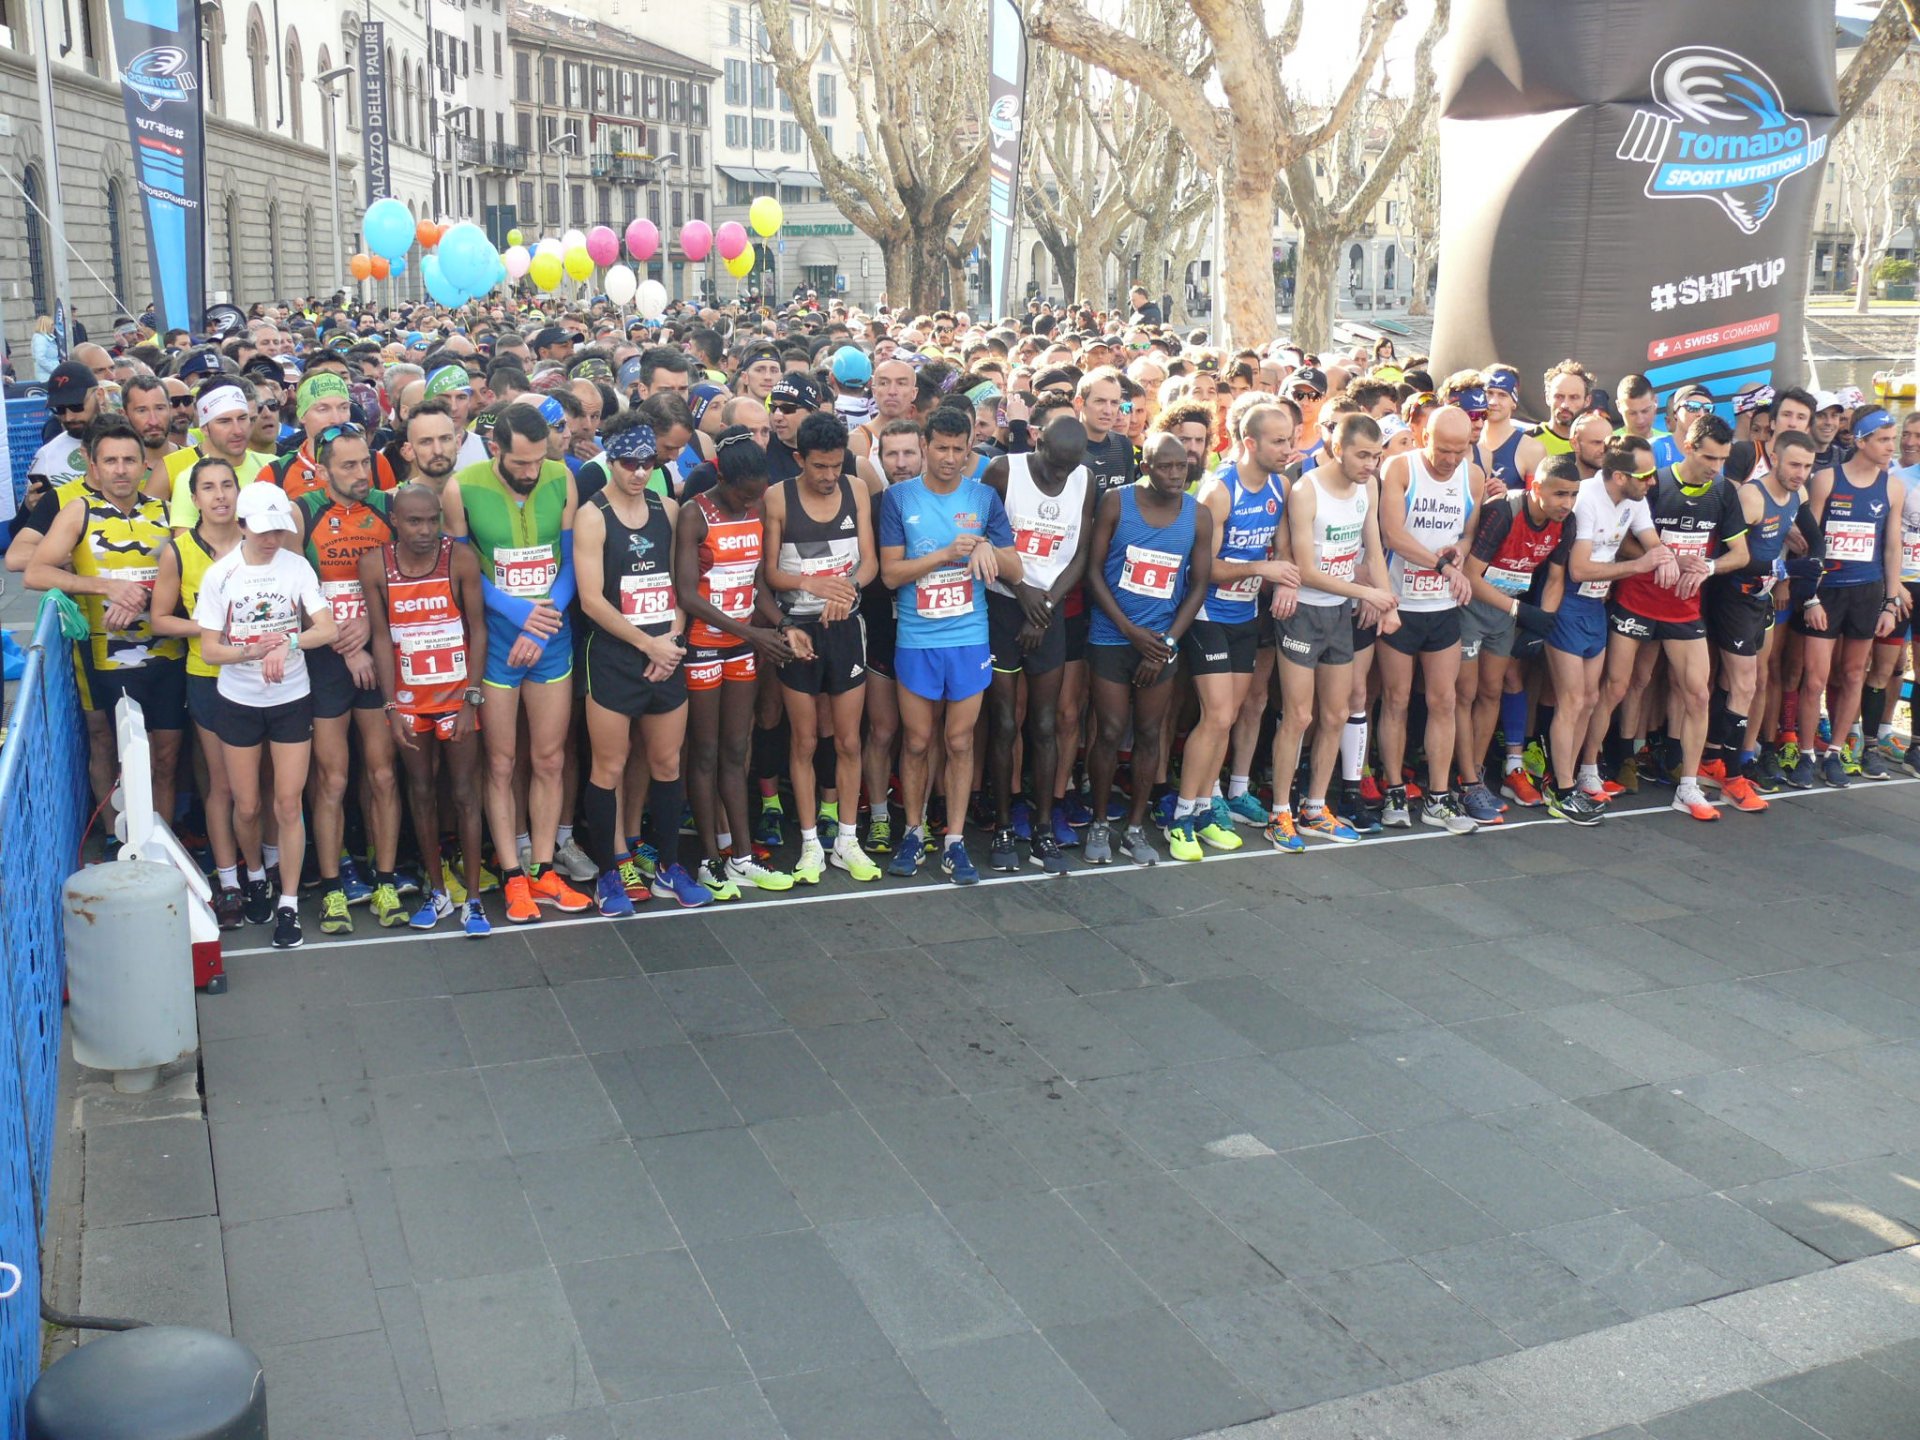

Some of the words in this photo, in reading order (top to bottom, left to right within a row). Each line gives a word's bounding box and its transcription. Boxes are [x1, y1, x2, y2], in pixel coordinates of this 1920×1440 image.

[364, 24, 378, 76] PAURE
[367, 81, 382, 127] DELLE
[369, 131, 386, 203] PALAZZO
[1665, 169, 1724, 186] SPORT
[1726, 153, 1803, 183] NUTRITION
[1650, 258, 1786, 312] #SHIFTUP
[1672, 341, 1683, 352] A
[1684, 332, 1720, 349] SWISS
[1722, 321, 1771, 341] COMPANY
[1043, 504, 1055, 515] 40
[1413, 498, 1438, 513] A.D.M.
[717, 533, 759, 550] serim
[1228, 526, 1276, 547] tomm
[1325, 524, 1362, 541] tomm
[1026, 537, 1040, 554] 5
[508, 567, 546, 586] 656
[1143, 569, 1156, 587] 6
[1415, 576, 1443, 591] 654
[256, 592, 287, 604] SANTI
[394, 595, 448, 613] serim
[632, 591, 669, 614] 758
[733, 592, 744, 610] 2
[925, 586, 965, 609] 735
[425, 655, 437, 674] 1
[690, 664, 722, 679] serim
